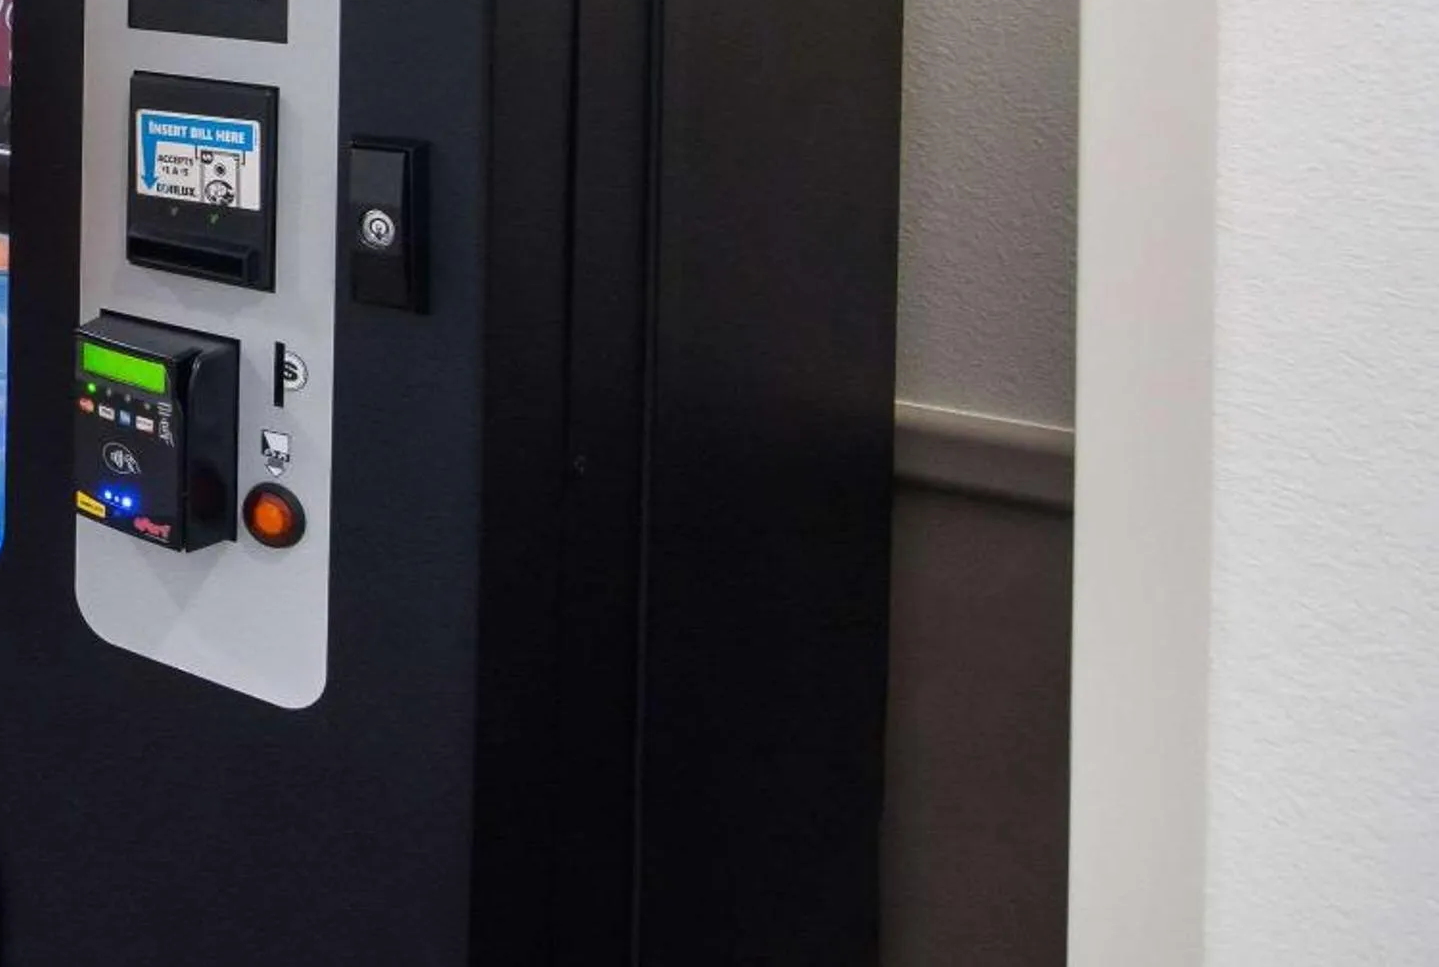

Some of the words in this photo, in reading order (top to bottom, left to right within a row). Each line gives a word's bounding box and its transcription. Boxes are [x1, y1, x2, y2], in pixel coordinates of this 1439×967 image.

[148, 120, 187, 139] INSERT
[190, 127, 213, 141] BILL
[215, 130, 245, 144] HERE
